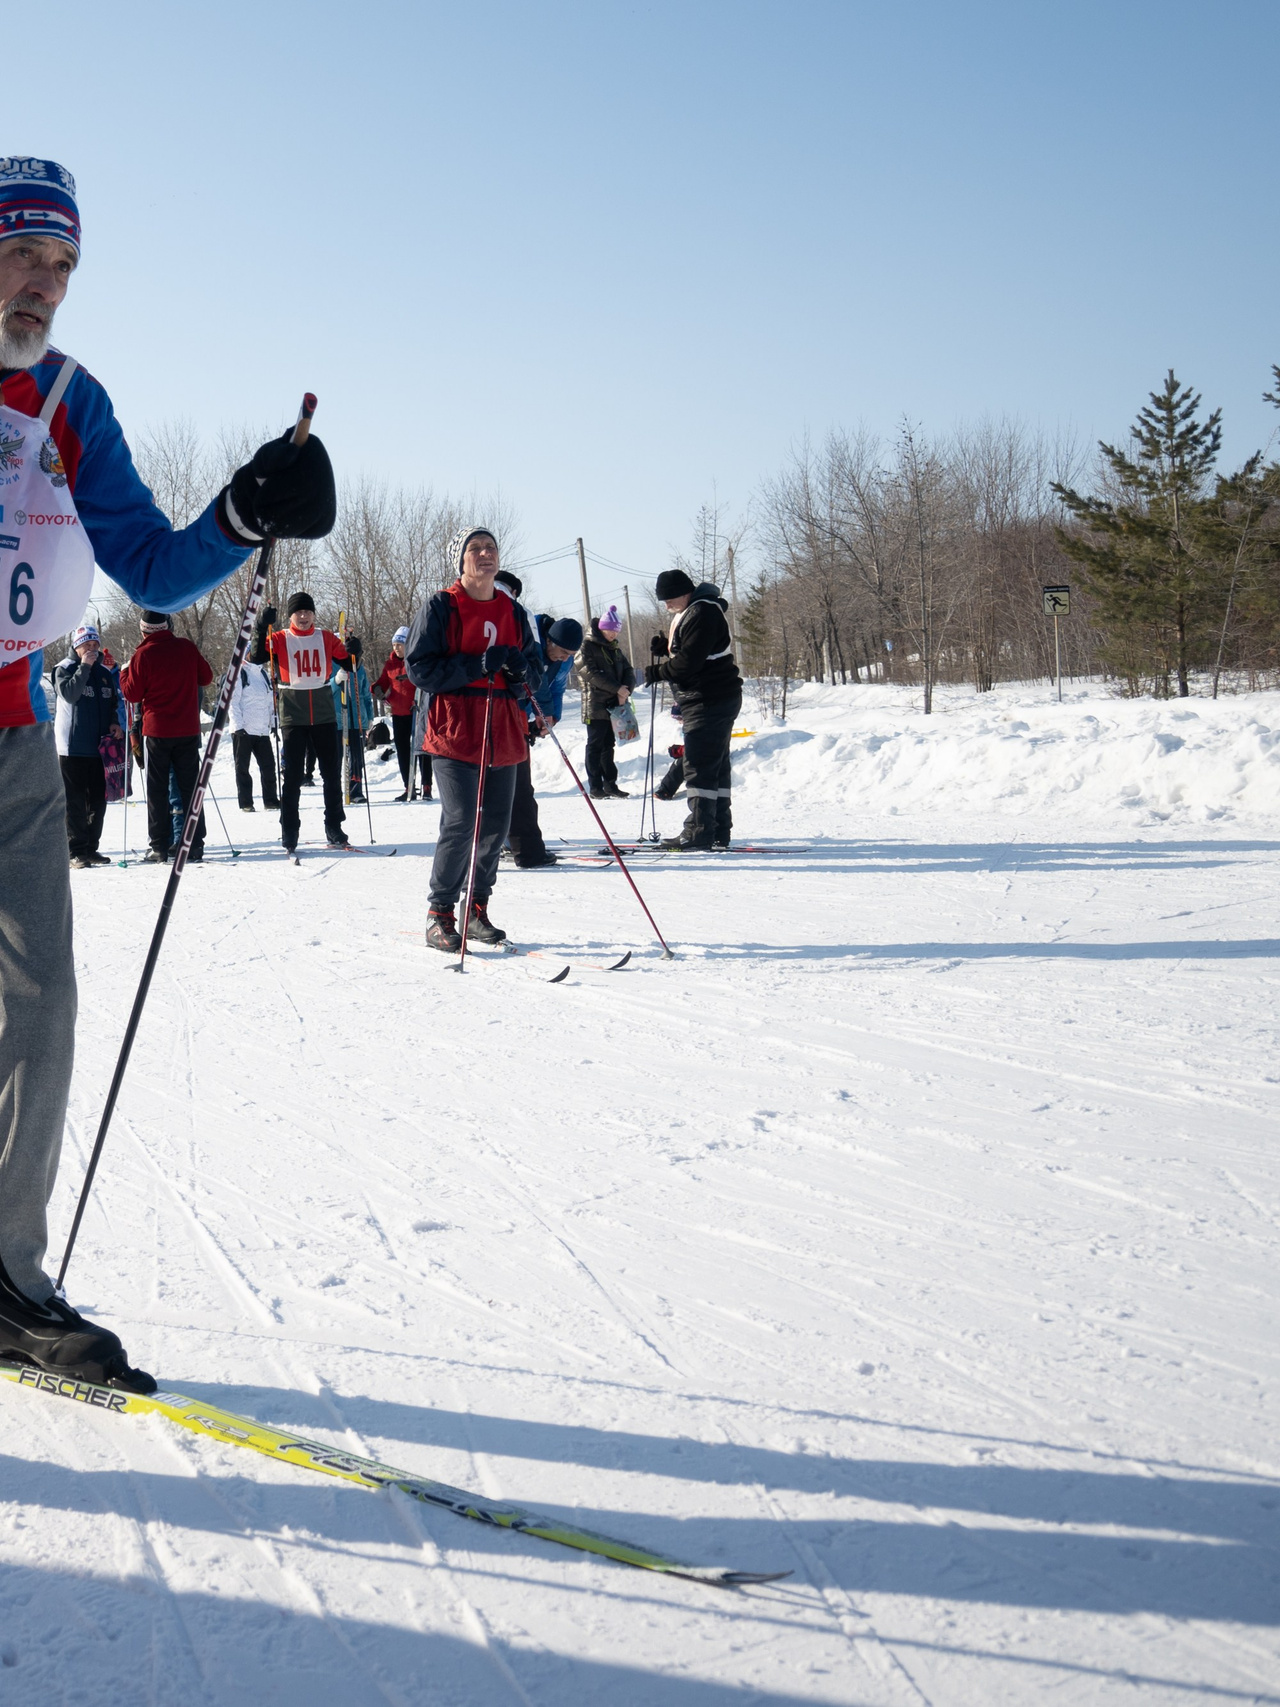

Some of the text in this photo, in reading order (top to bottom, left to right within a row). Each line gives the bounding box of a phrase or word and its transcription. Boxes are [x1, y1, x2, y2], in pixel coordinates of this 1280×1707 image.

[28, 514, 79, 526] TOYOTA
[293, 648, 322, 678] 144
[19, 1366, 128, 1414] FISCHER
